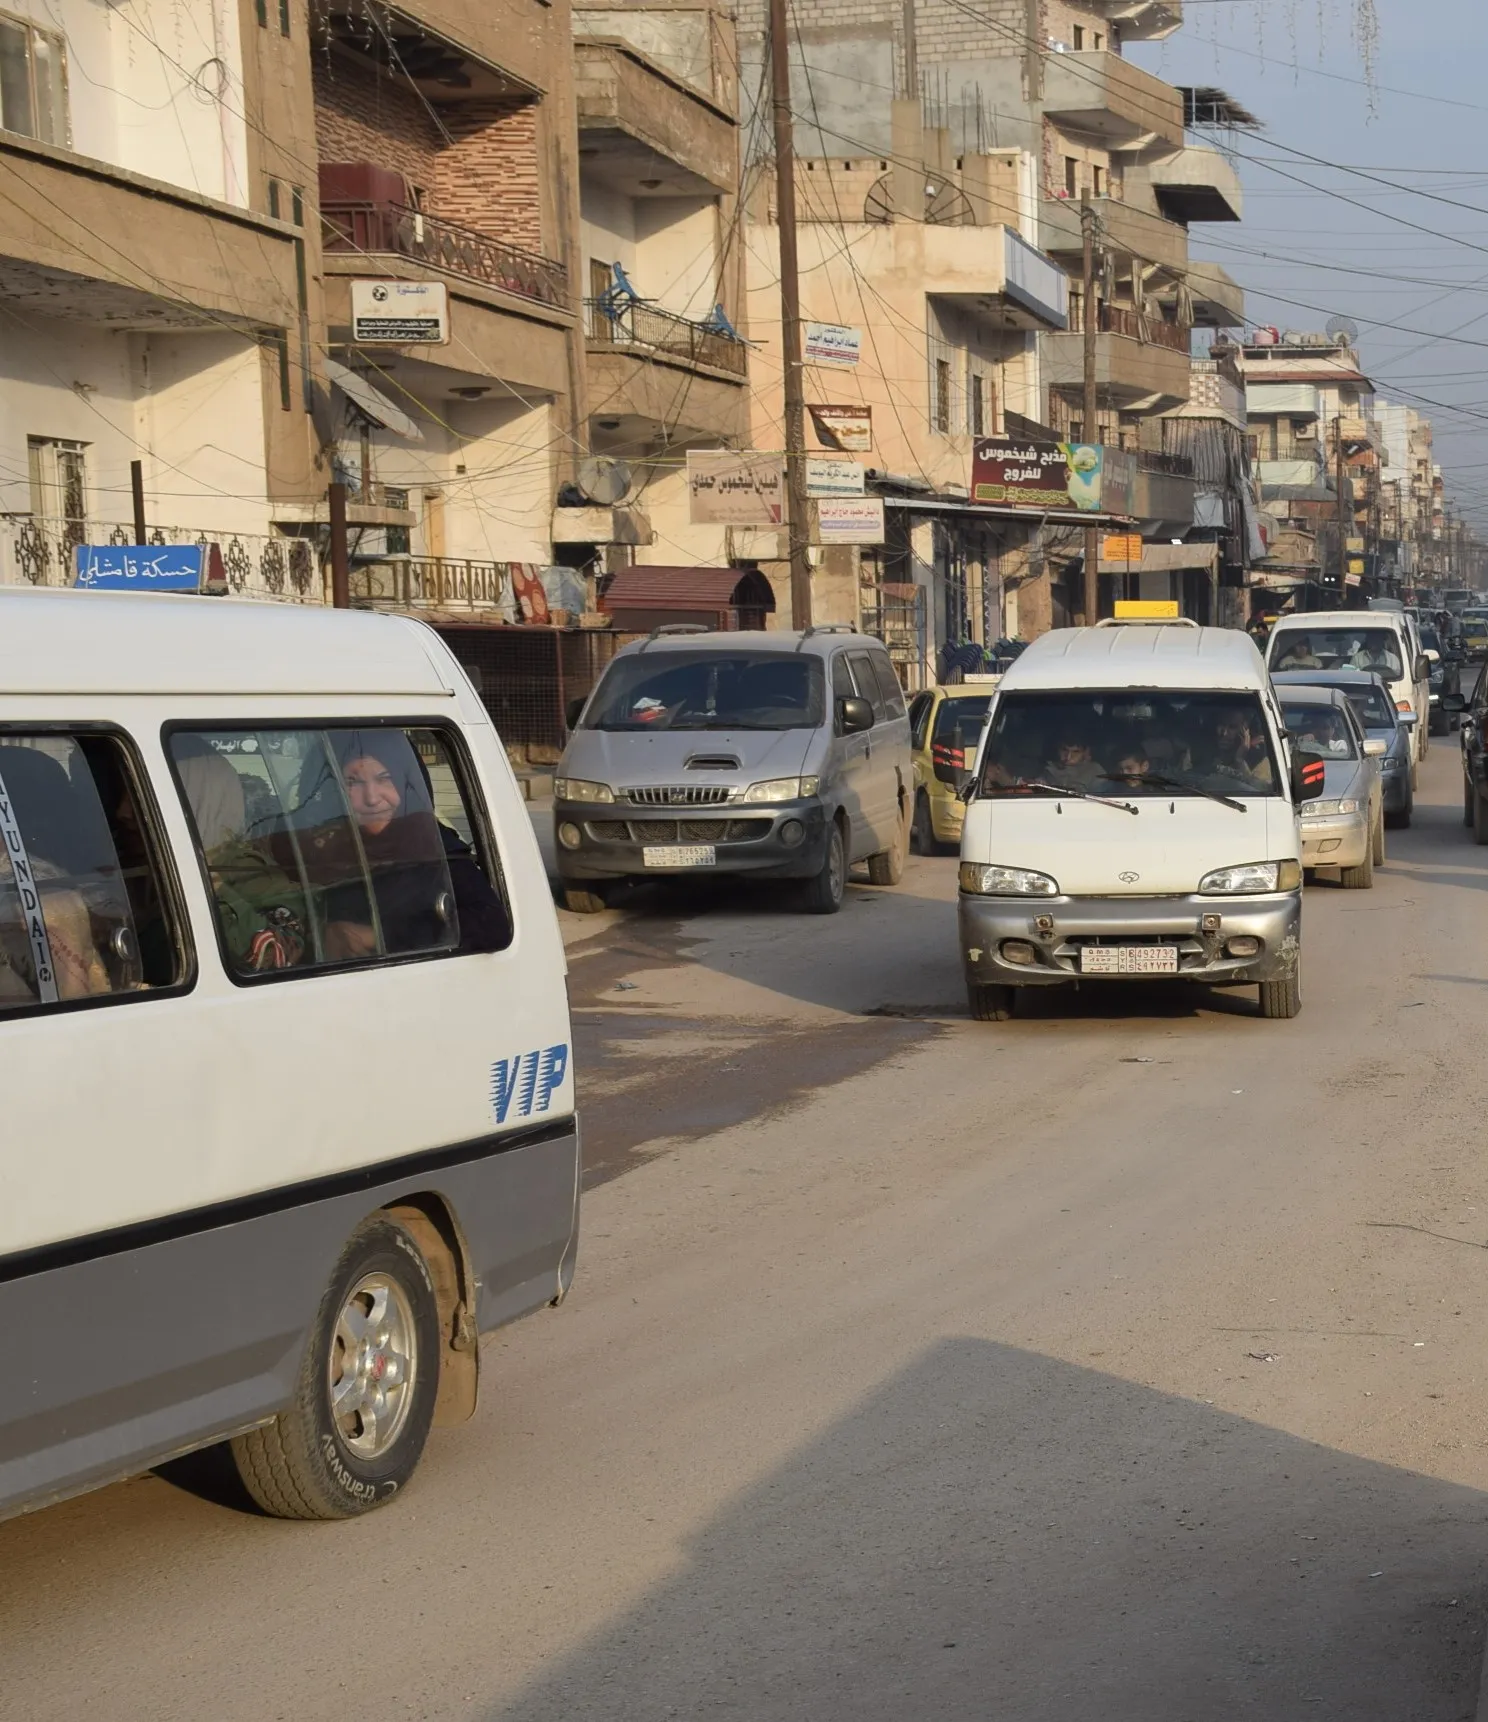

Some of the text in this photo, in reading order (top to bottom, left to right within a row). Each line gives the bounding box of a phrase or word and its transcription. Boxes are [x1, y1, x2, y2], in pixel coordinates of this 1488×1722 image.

[979, 445, 1067, 466] مذبح شيخموس
[1003, 467, 1041, 482] للفروج
[79, 555, 197, 585] حسكة قامشلي
[0, 779, 44, 966] YUNDAI
[1137, 949, 1175, 959] 492732
[488, 1043, 568, 1124] VIP
